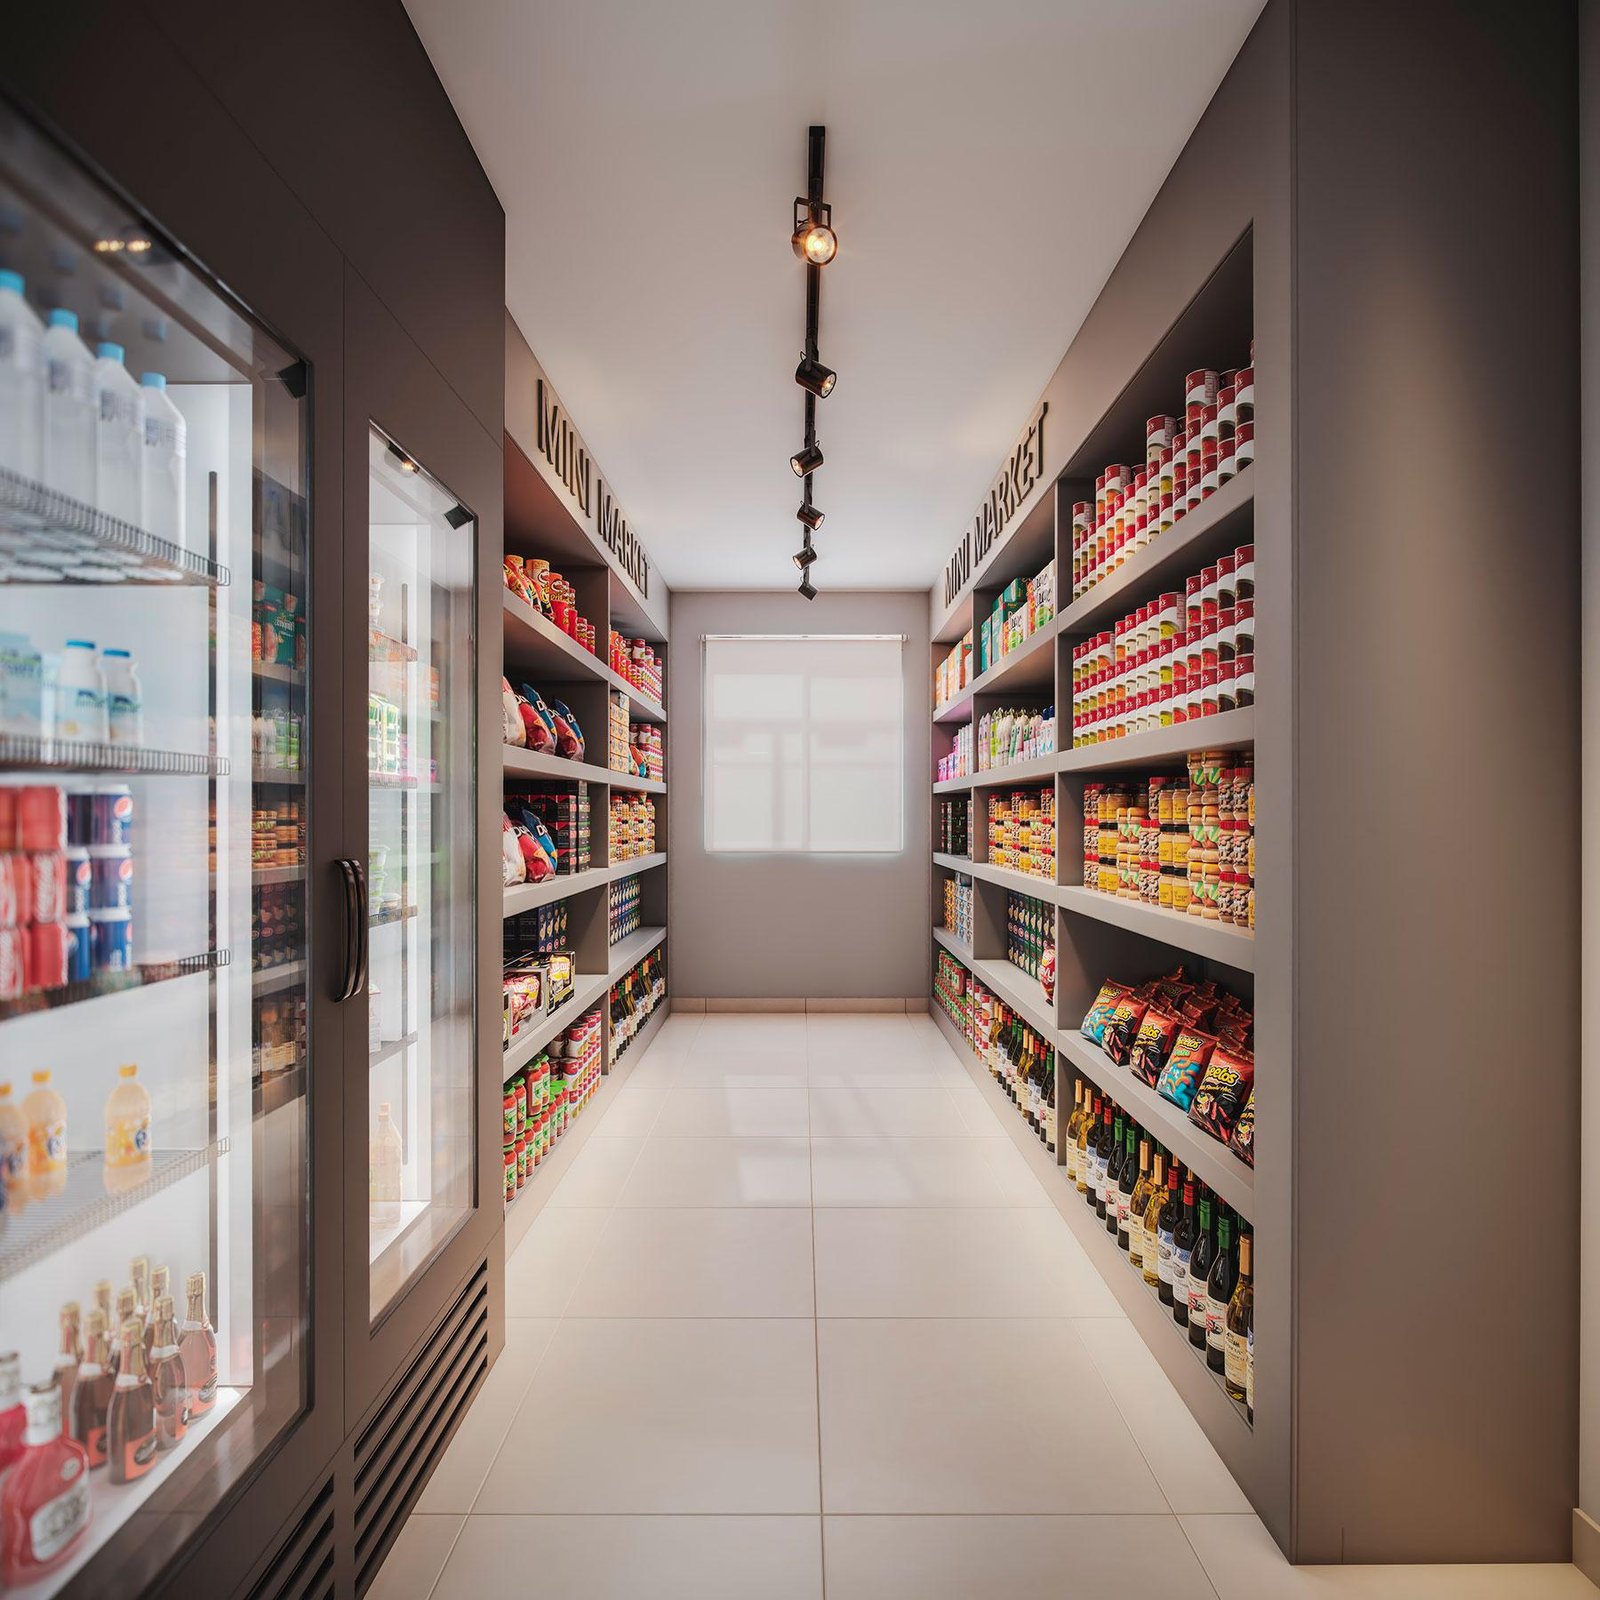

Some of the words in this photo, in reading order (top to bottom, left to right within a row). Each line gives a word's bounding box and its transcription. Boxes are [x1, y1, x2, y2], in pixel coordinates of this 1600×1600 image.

[537, 379, 591, 518] MINI
[598, 479, 650, 600] MARKET
[945, 532, 970, 609] MINI
[974, 402, 1048, 567] MARKET
[1206, 1066, 1238, 1084] eetos
